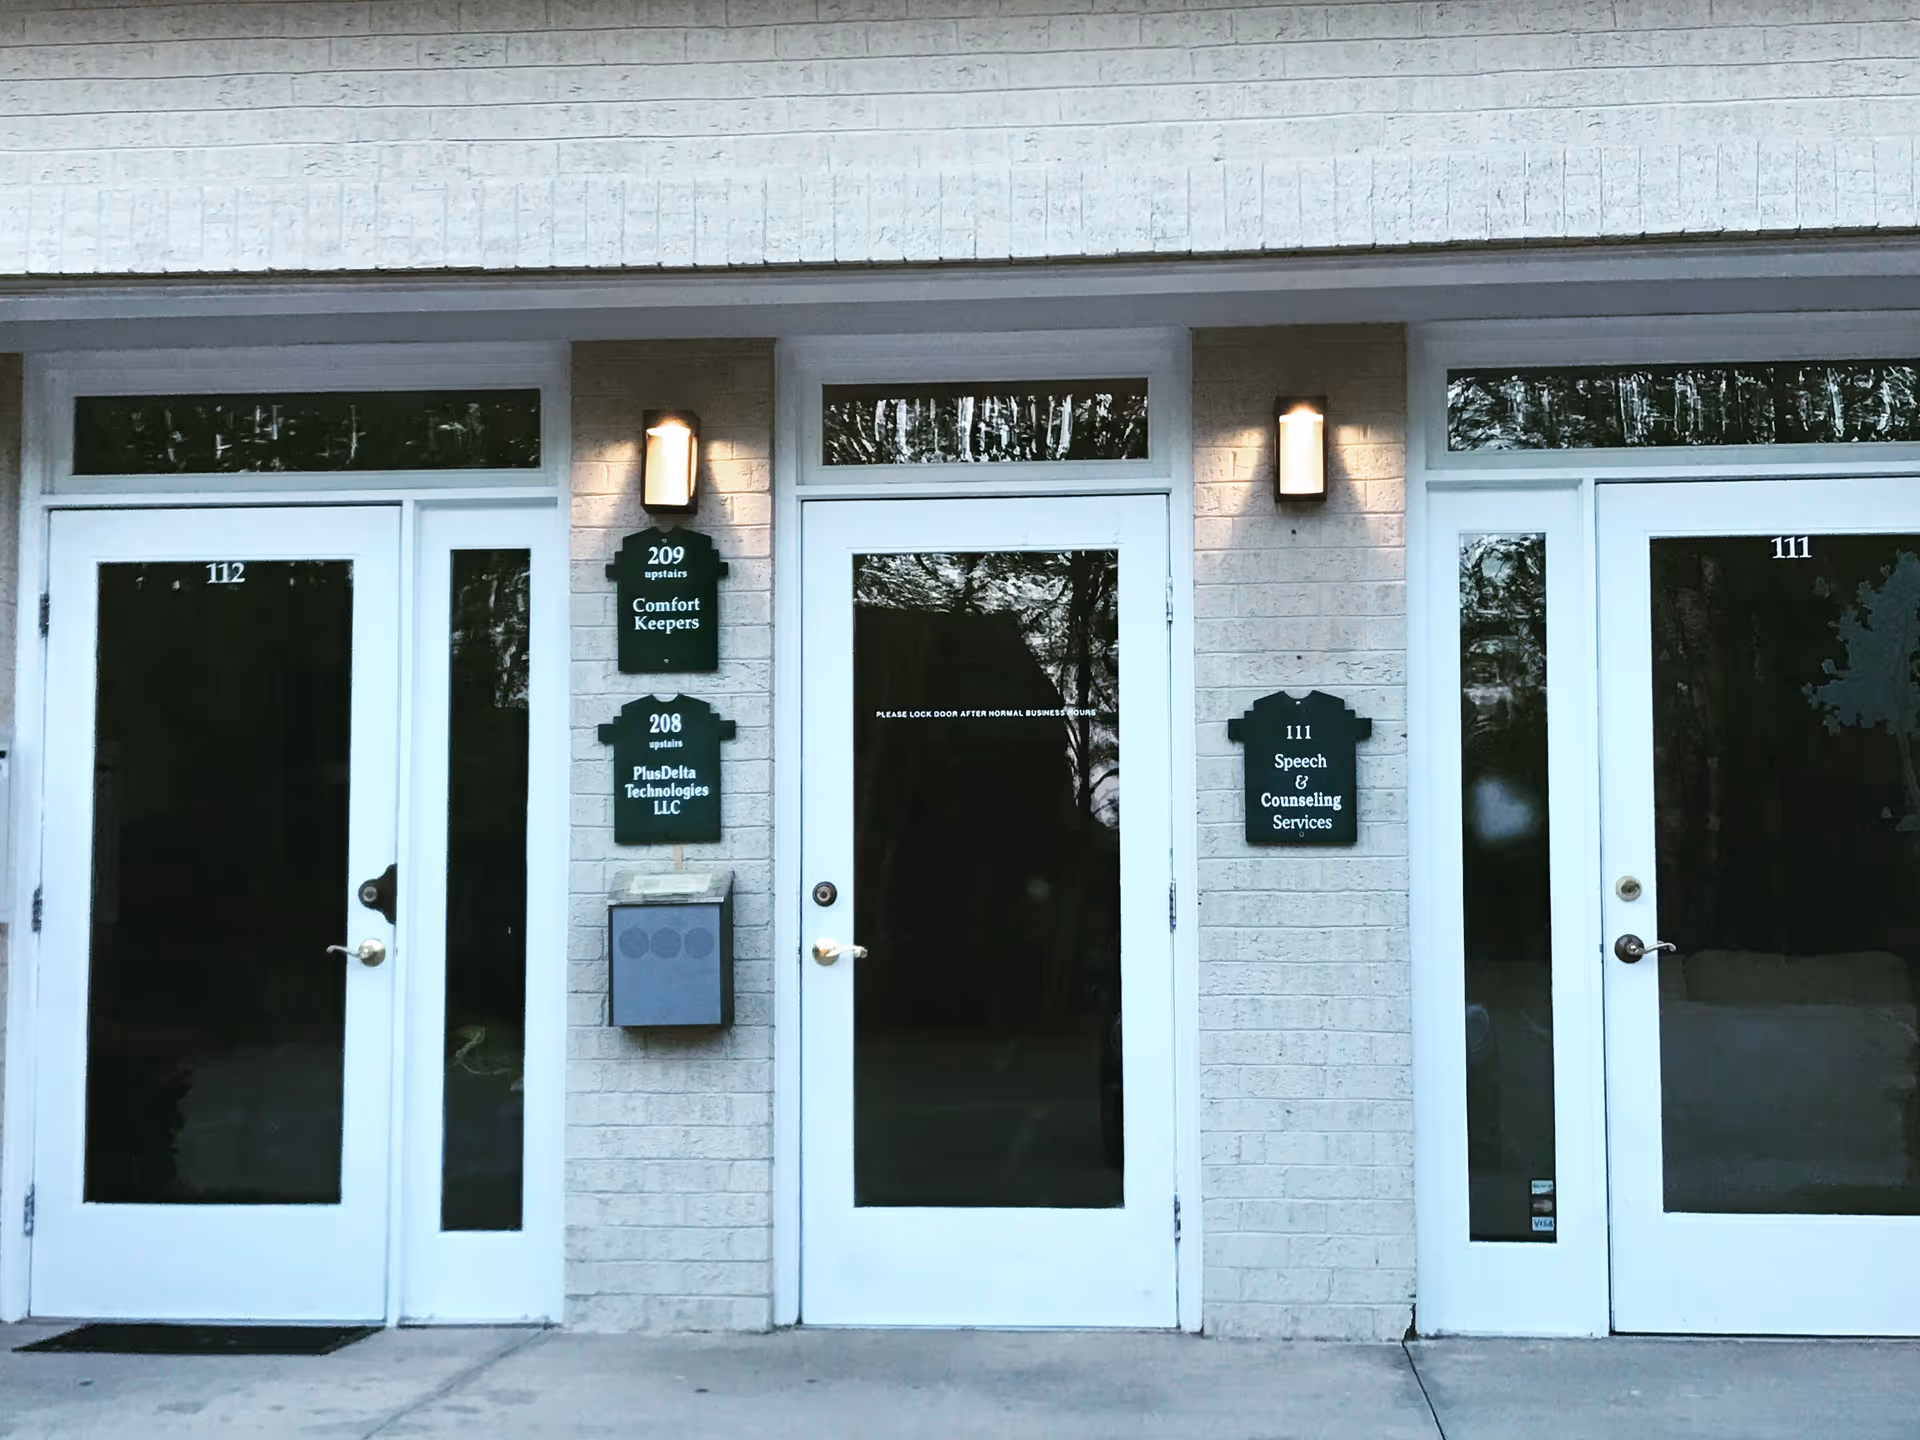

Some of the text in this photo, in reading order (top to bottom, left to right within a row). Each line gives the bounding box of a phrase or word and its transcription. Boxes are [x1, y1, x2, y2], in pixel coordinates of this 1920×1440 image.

[1771, 536, 1812, 558] 111
[647, 546, 685, 565] 209
[205, 562, 246, 584] 112
[644, 569, 688, 580] upstairs
[632, 597, 701, 613] Comfort
[634, 616, 700, 634] Keepers
[876, 710, 907, 718] PLEASE
[909, 710, 932, 718] LOCK
[934, 710, 958, 718] DOOR
[1025, 709, 1065, 717] BUSINESS
[649, 713, 682, 733] 208
[1286, 725, 1312, 739] 111
[649, 739, 683, 750] upstairs
[1274, 753, 1327, 771] Speech
[633, 765, 696, 781] PlusDelta
[1295, 775, 1309, 790] &
[624, 783, 709, 800] Technologies
[653, 800, 681, 816] LLC
[1260, 792, 1342, 811] Counseling
[1272, 814, 1333, 829] Services
[1533, 1220, 1554, 1228] VISA
